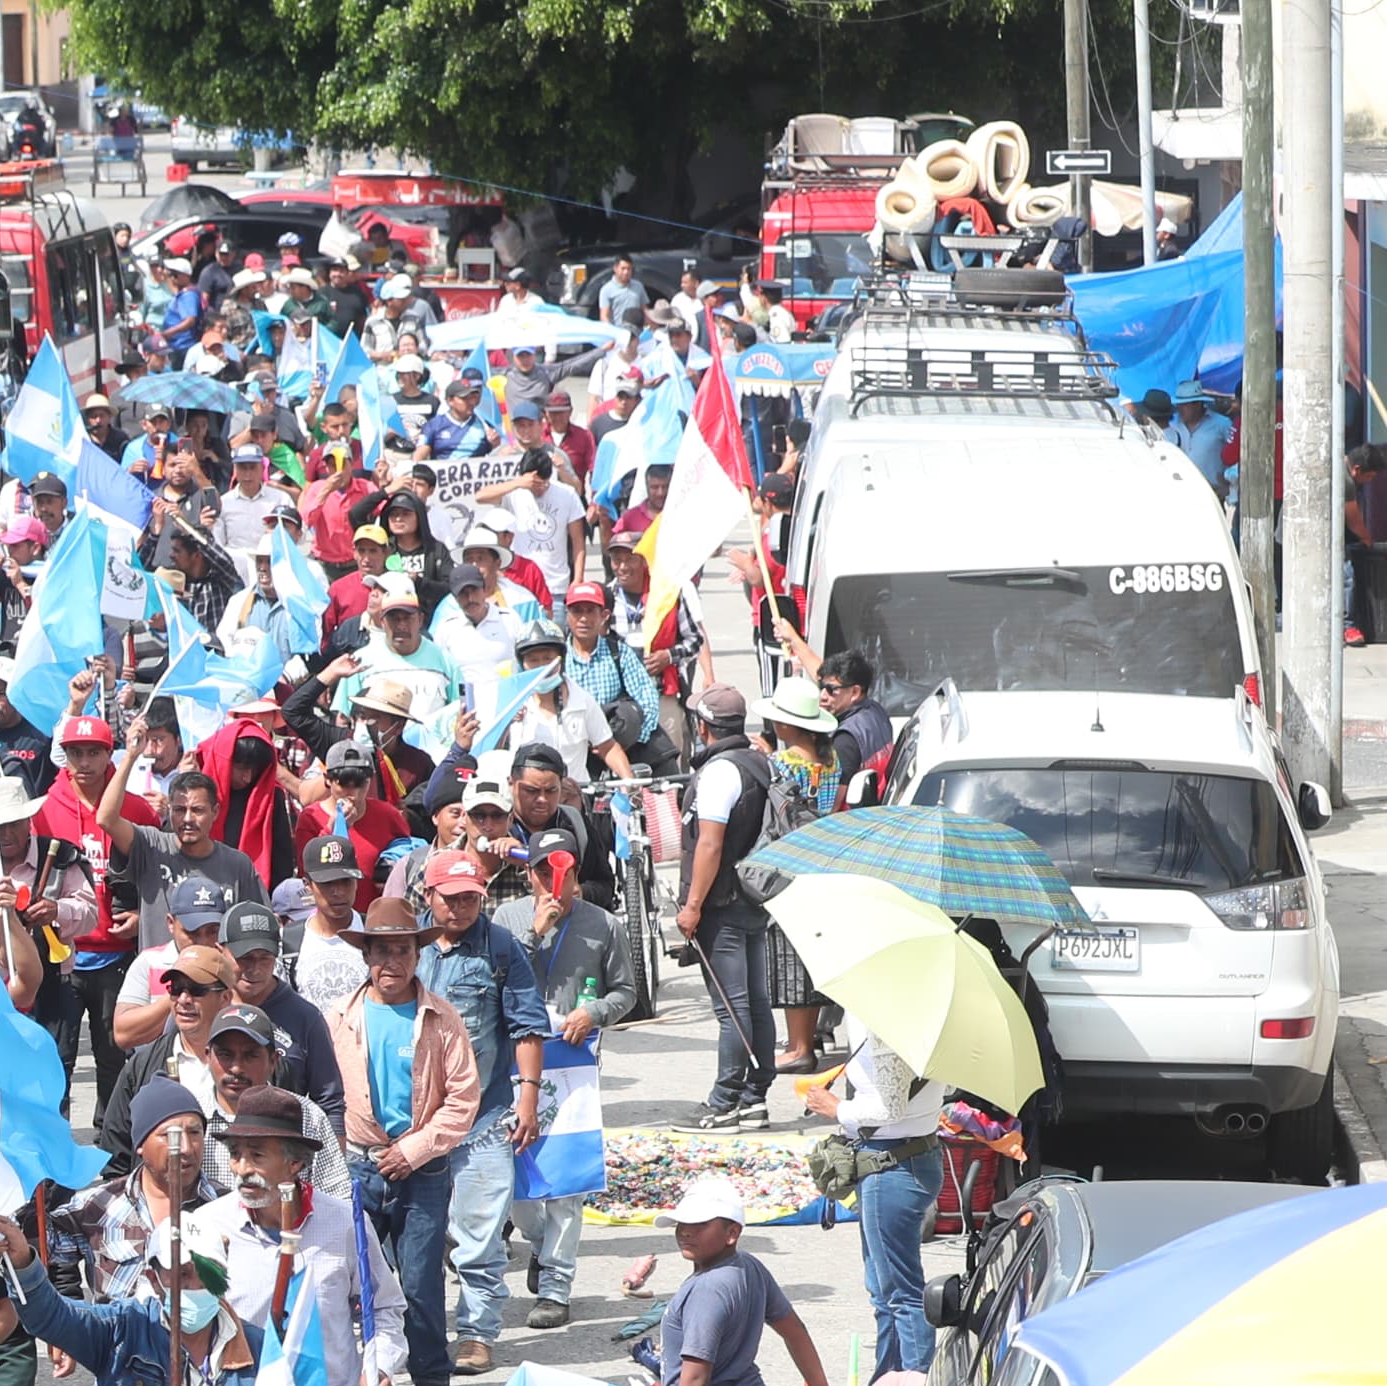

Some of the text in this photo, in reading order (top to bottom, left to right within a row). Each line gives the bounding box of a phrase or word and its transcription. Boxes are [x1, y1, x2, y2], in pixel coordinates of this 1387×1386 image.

[436, 464, 473, 488] ERA
[1109, 564, 1223, 595] C-886BSG
[1058, 936, 1134, 960] P692JXL
